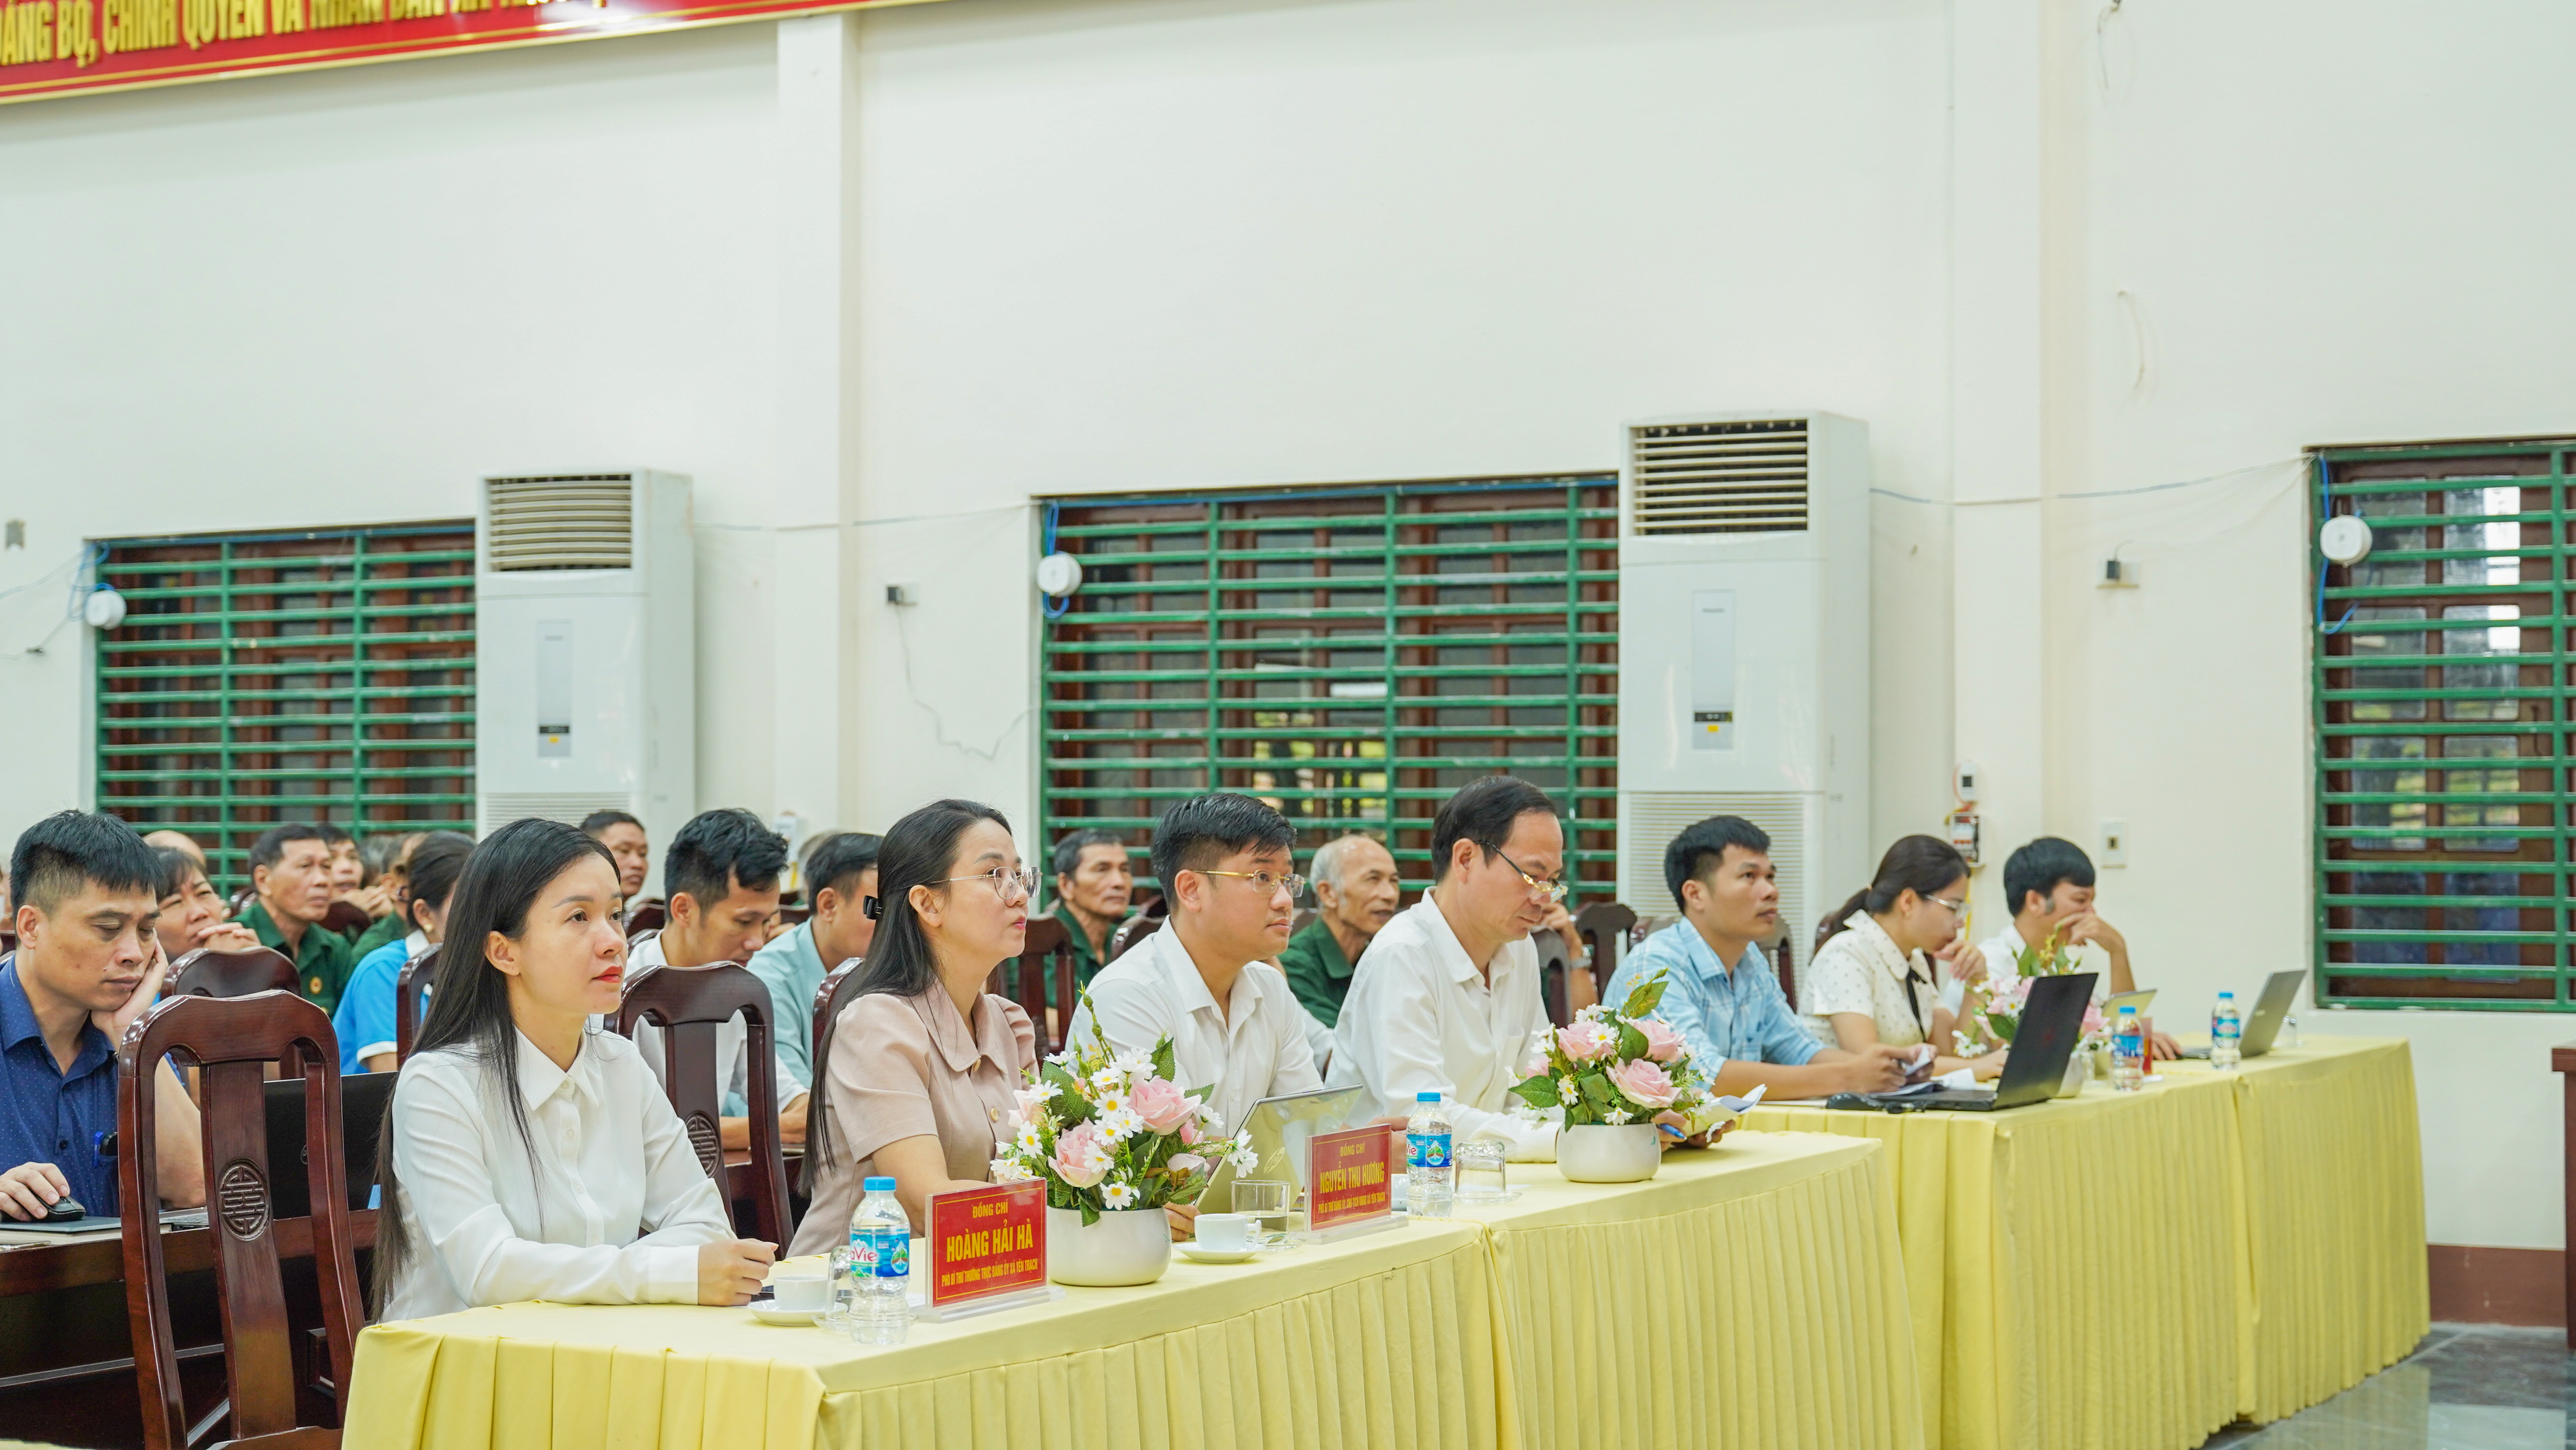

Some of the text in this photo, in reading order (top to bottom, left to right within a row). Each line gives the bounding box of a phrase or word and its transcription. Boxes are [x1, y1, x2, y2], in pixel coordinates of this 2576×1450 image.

[0, 0, 54, 65] ẢNG
[1355, 1141, 1365, 1154] CHÍ
[1320, 1161, 1347, 1194] NGUYỄN
[1348, 1165, 1361, 1188] THU
[995, 1199, 1009, 1215] CHÍ
[946, 1218, 1033, 1263] HOÀNG HẢI HÀ
[851, 1247, 877, 1262] aVie
[1016, 1258, 1024, 1273] YÊN
[1025, 1258, 1038, 1273] TRẠCH
